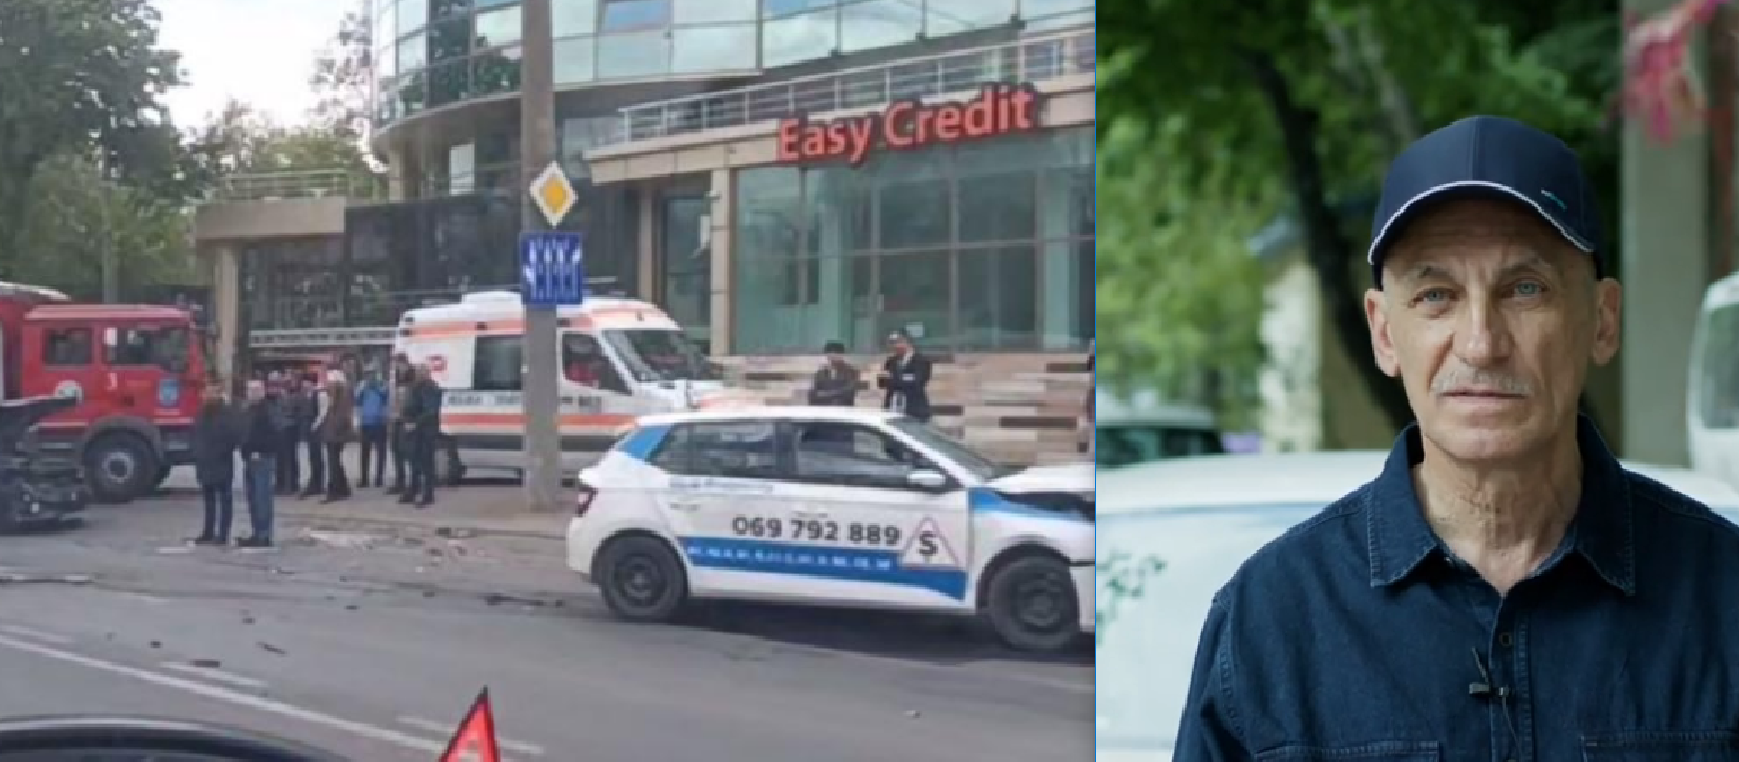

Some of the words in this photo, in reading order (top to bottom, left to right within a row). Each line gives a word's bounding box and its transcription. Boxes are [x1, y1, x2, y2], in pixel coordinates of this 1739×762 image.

[778, 117, 872, 163] Easy
[885, 84, 1036, 146] Credit
[732, 516, 782, 538] 069
[790, 519, 838, 541] 792
[849, 522, 901, 546] 889
[918, 530, 939, 556] S
